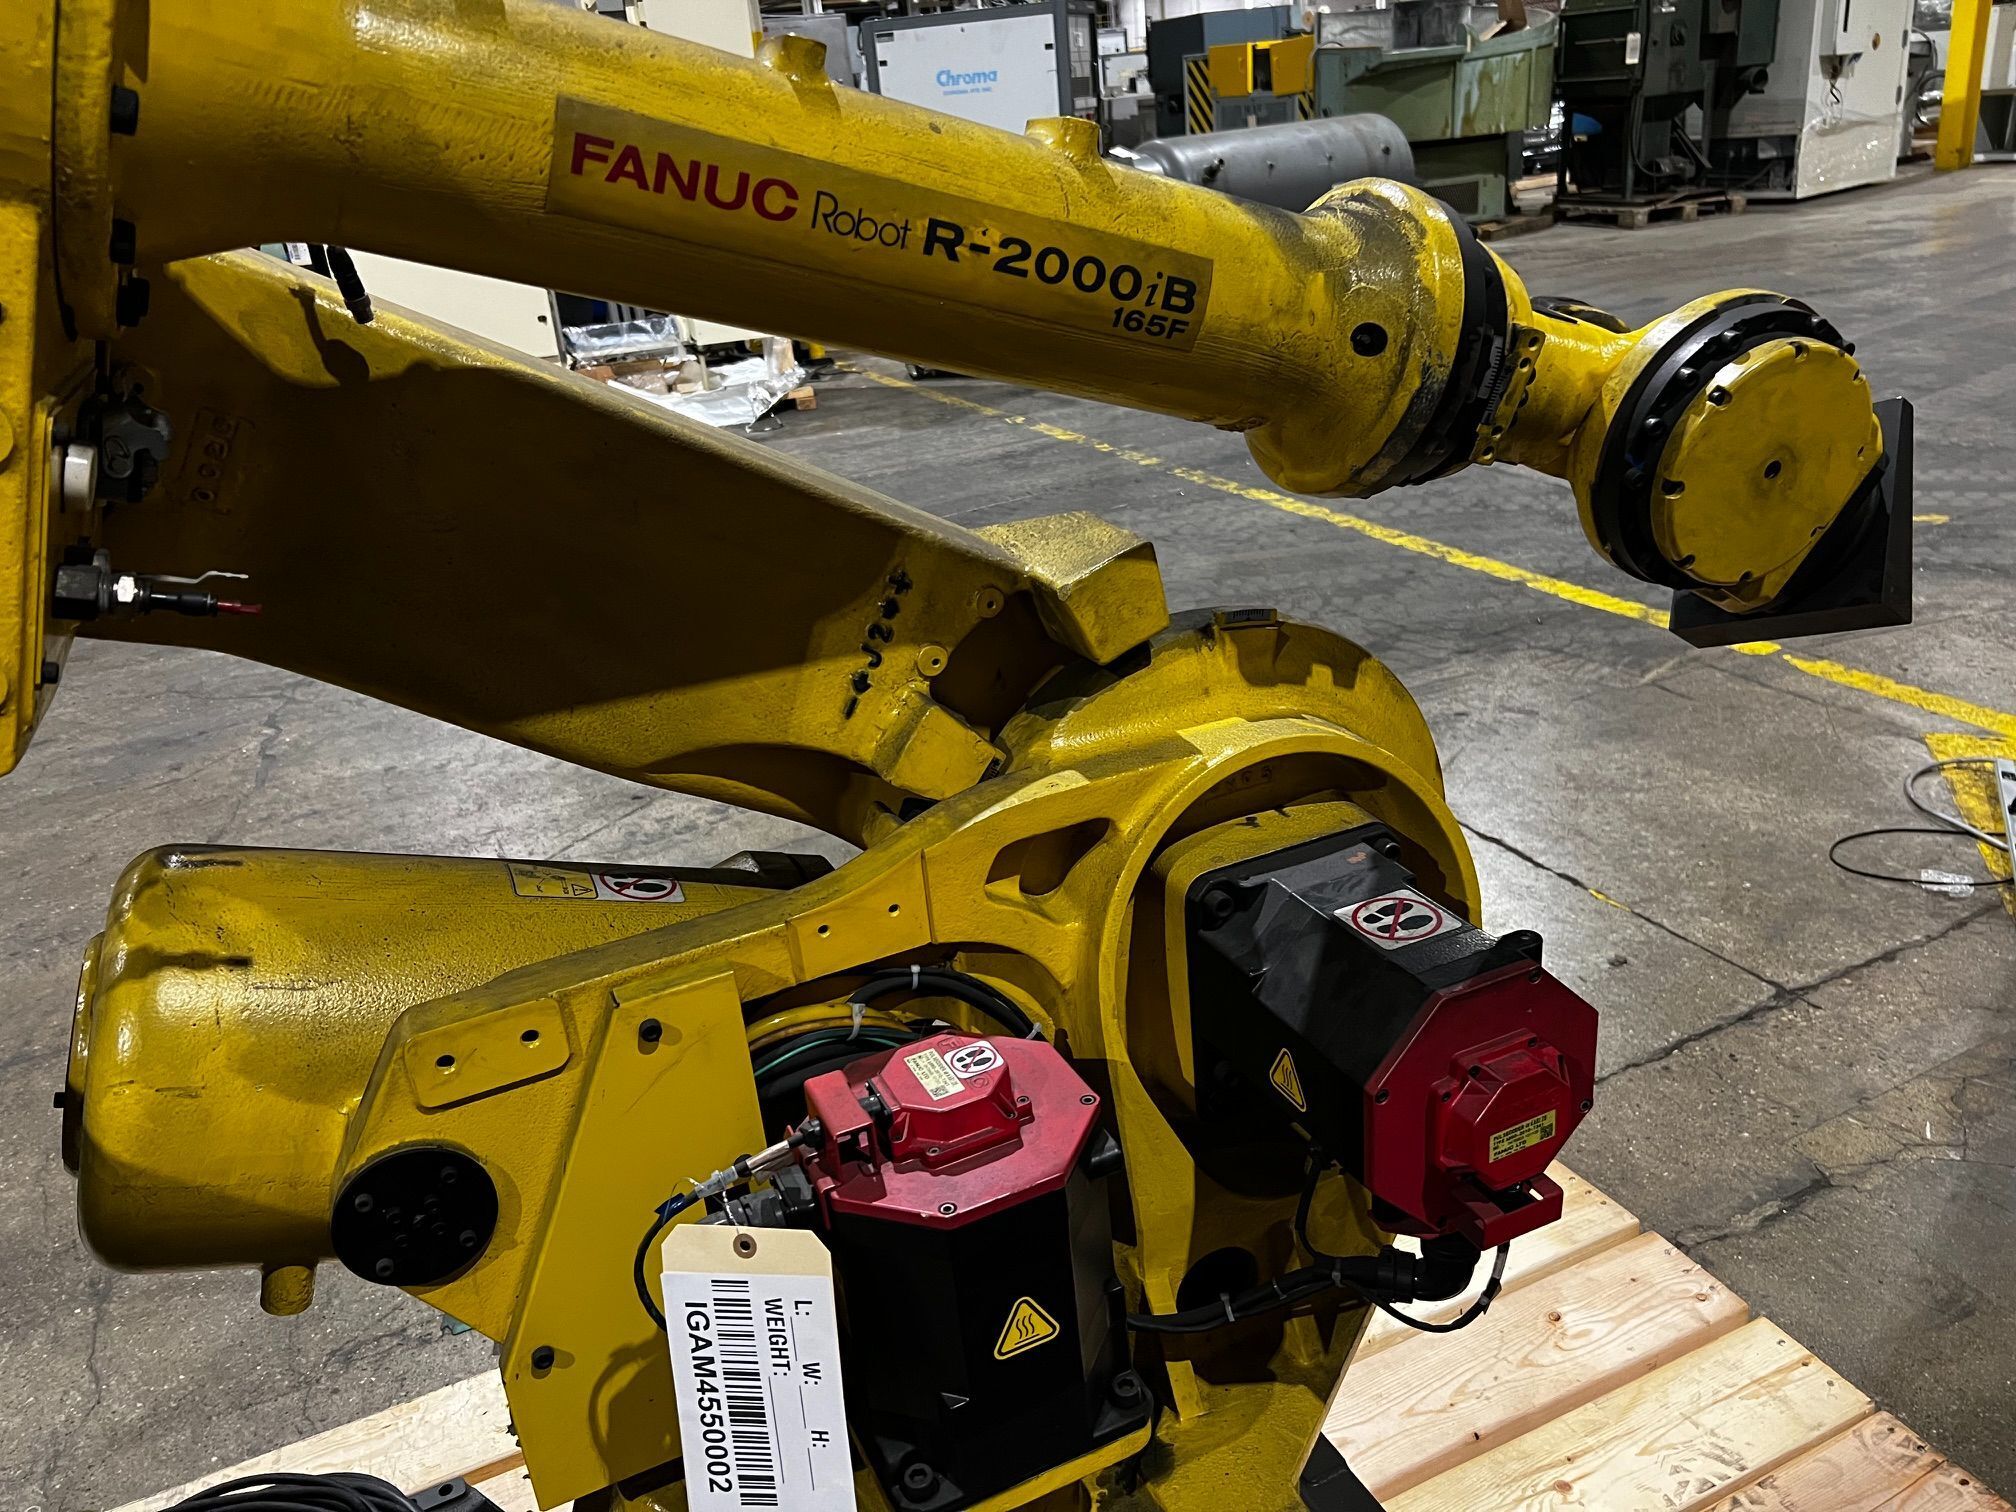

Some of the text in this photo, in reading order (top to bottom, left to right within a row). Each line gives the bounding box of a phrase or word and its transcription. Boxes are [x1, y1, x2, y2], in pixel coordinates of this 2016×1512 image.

[937, 69, 998, 87] Chroma
[570, 132, 1197, 315] FANUC Robot R-2000iB
[1112, 307, 1190, 340] 165F
[764, 1298, 791, 1376] WEIGHT:
[794, 1300, 830, 1448] L: W: H:
[684, 1301, 733, 1493] IGAM4550002
